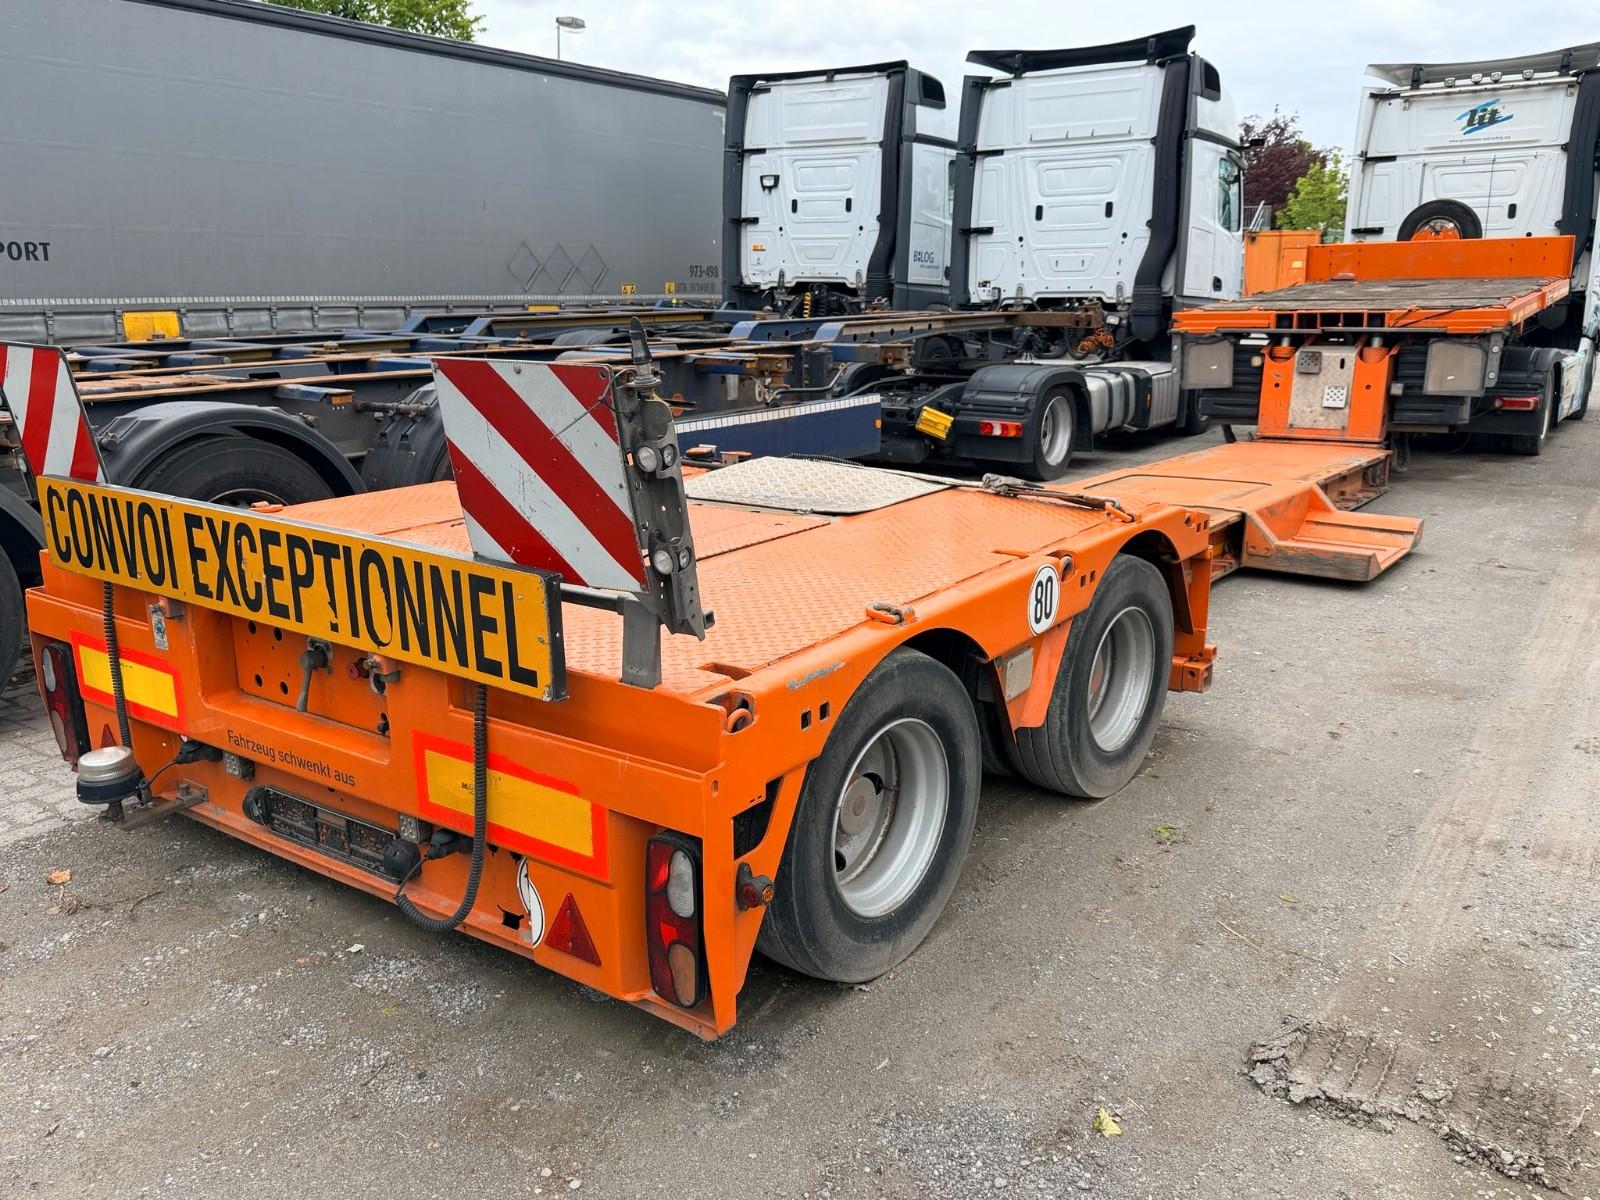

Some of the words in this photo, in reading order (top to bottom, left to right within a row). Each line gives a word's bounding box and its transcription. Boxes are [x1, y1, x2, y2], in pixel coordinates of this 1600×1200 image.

[47, 485, 179, 590] CONVOI
[184, 512, 539, 689] EXCEPTIONNEL
[1034, 575, 1053, 624] 80
[227, 729, 276, 762] Fahrzeug
[278, 749, 331, 779] schwenkt
[334, 768, 356, 787] aus
